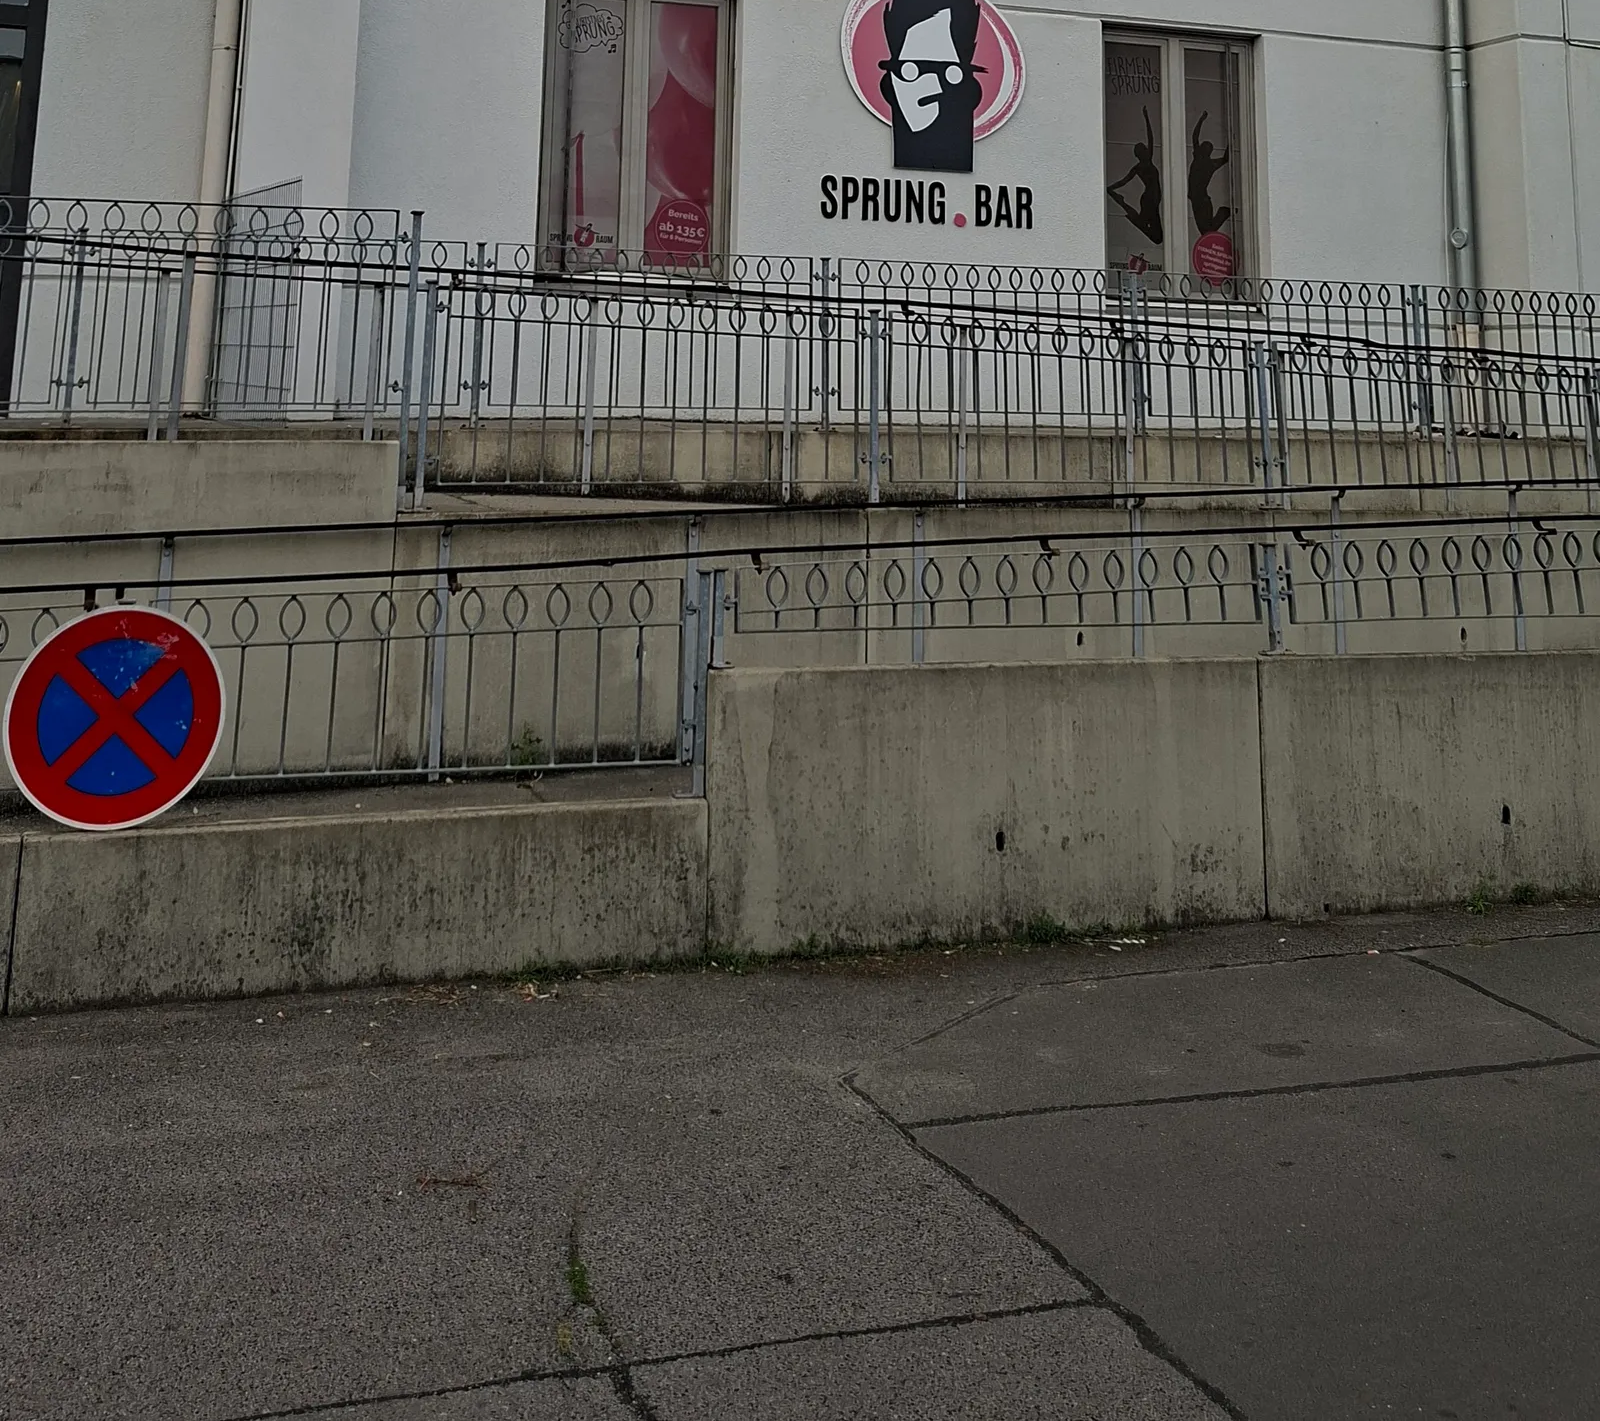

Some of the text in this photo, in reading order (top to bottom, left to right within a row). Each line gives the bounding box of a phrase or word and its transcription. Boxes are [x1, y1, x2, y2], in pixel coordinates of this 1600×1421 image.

[574, 20, 616, 44] PRUNG
[1106, 56, 1152, 77] FIRMEN
[1111, 72, 1160, 96] SPRUNG
[668, 209, 699, 222] Bereits
[659, 221, 706, 238] ab 135€
[596, 235, 614, 244] RAUM
